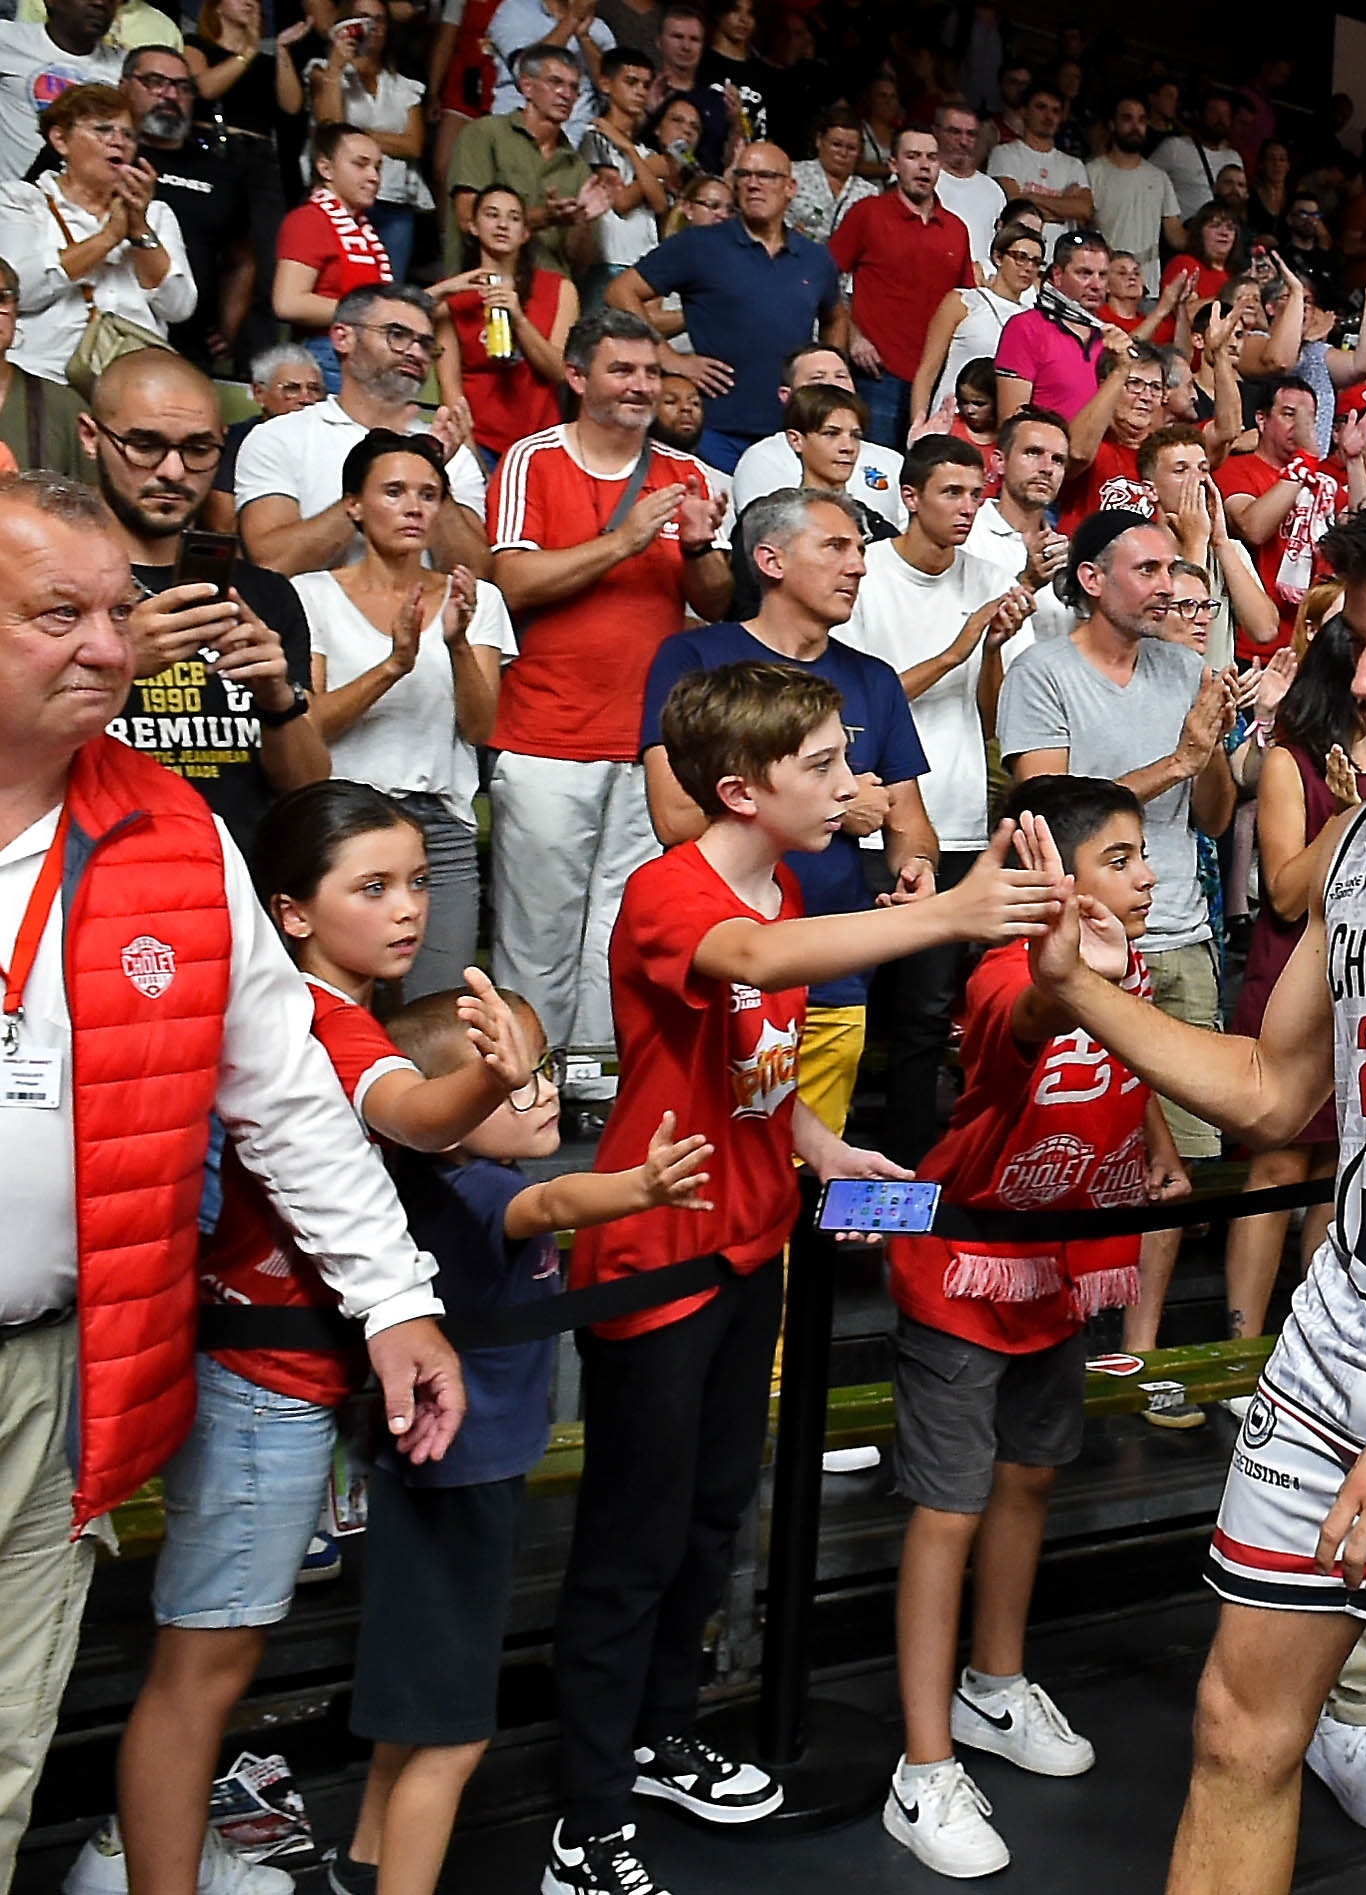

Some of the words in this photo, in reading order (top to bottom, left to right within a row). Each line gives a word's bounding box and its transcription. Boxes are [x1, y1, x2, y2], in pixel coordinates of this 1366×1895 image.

[141, 687, 202, 713] 1990
[104, 716, 263, 749] REMIUM
[121, 951, 177, 977] CHOLET
[996, 1154, 1095, 1193] CHOLET
[1086, 1157, 1147, 1193] CHOL
